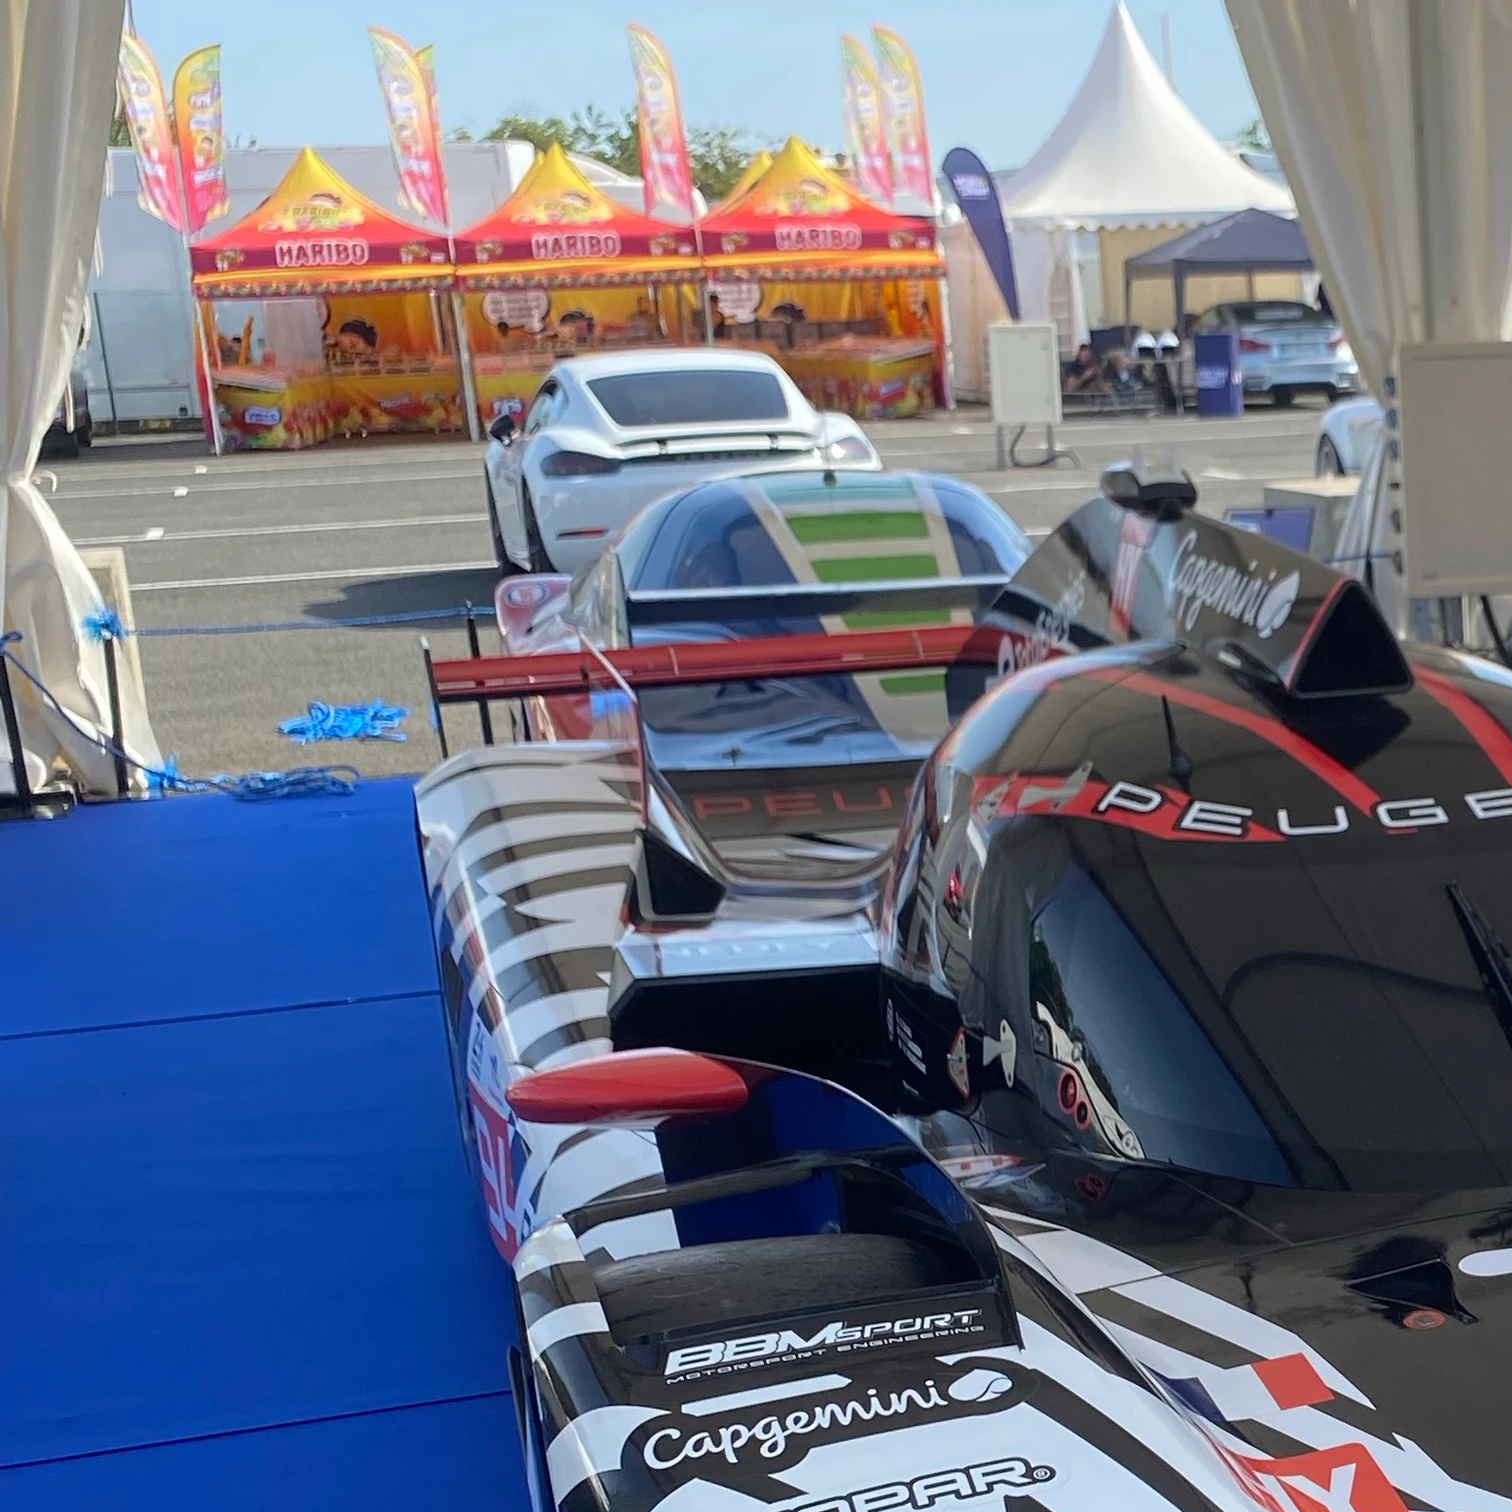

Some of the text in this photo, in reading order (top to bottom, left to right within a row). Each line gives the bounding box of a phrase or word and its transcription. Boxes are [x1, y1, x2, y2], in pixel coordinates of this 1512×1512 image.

[276, 239, 369, 267] HARIBO
[532, 232, 621, 259] HARIBO
[776, 223, 862, 250] HARIBO
[1169, 529, 1278, 633] Capgemini
[666, 1325, 986, 1386] MOTORSPORT ENGINEERING
[643, 1379, 949, 1471] Capgemini
